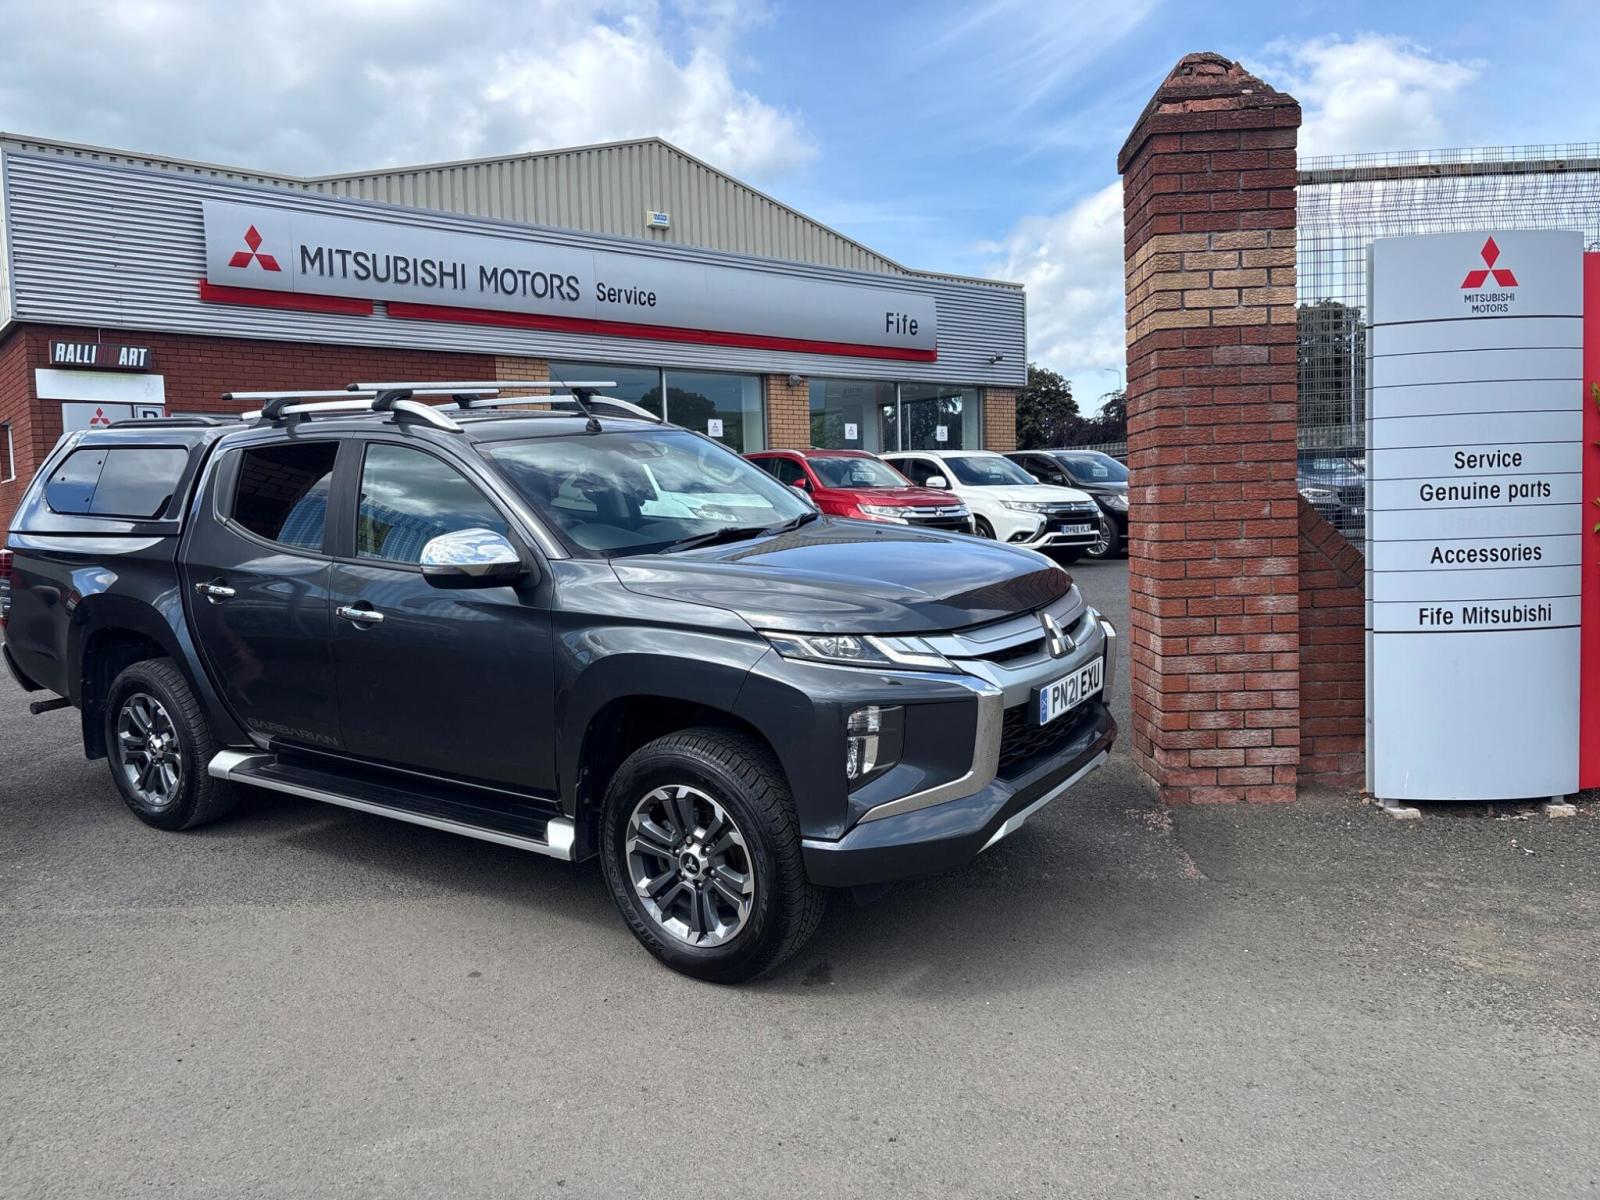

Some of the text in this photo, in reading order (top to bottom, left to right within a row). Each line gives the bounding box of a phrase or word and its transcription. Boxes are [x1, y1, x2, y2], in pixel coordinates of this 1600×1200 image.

[300, 244, 580, 301] MITSUBISHI MOTORS
[596, 282, 657, 307] Service
[1464, 293, 1515, 303] MITSUBISHI
[1471, 303, 1509, 313] MOTORS
[885, 312, 918, 336] Fife
[1454, 450, 1522, 469] Service
[1420, 480, 1551, 502] Genuine parts
[1430, 544, 1542, 564] Accessories
[1419, 604, 1552, 625] Fife Mitsubishi
[1052, 662, 1100, 714] PN21 EXU
